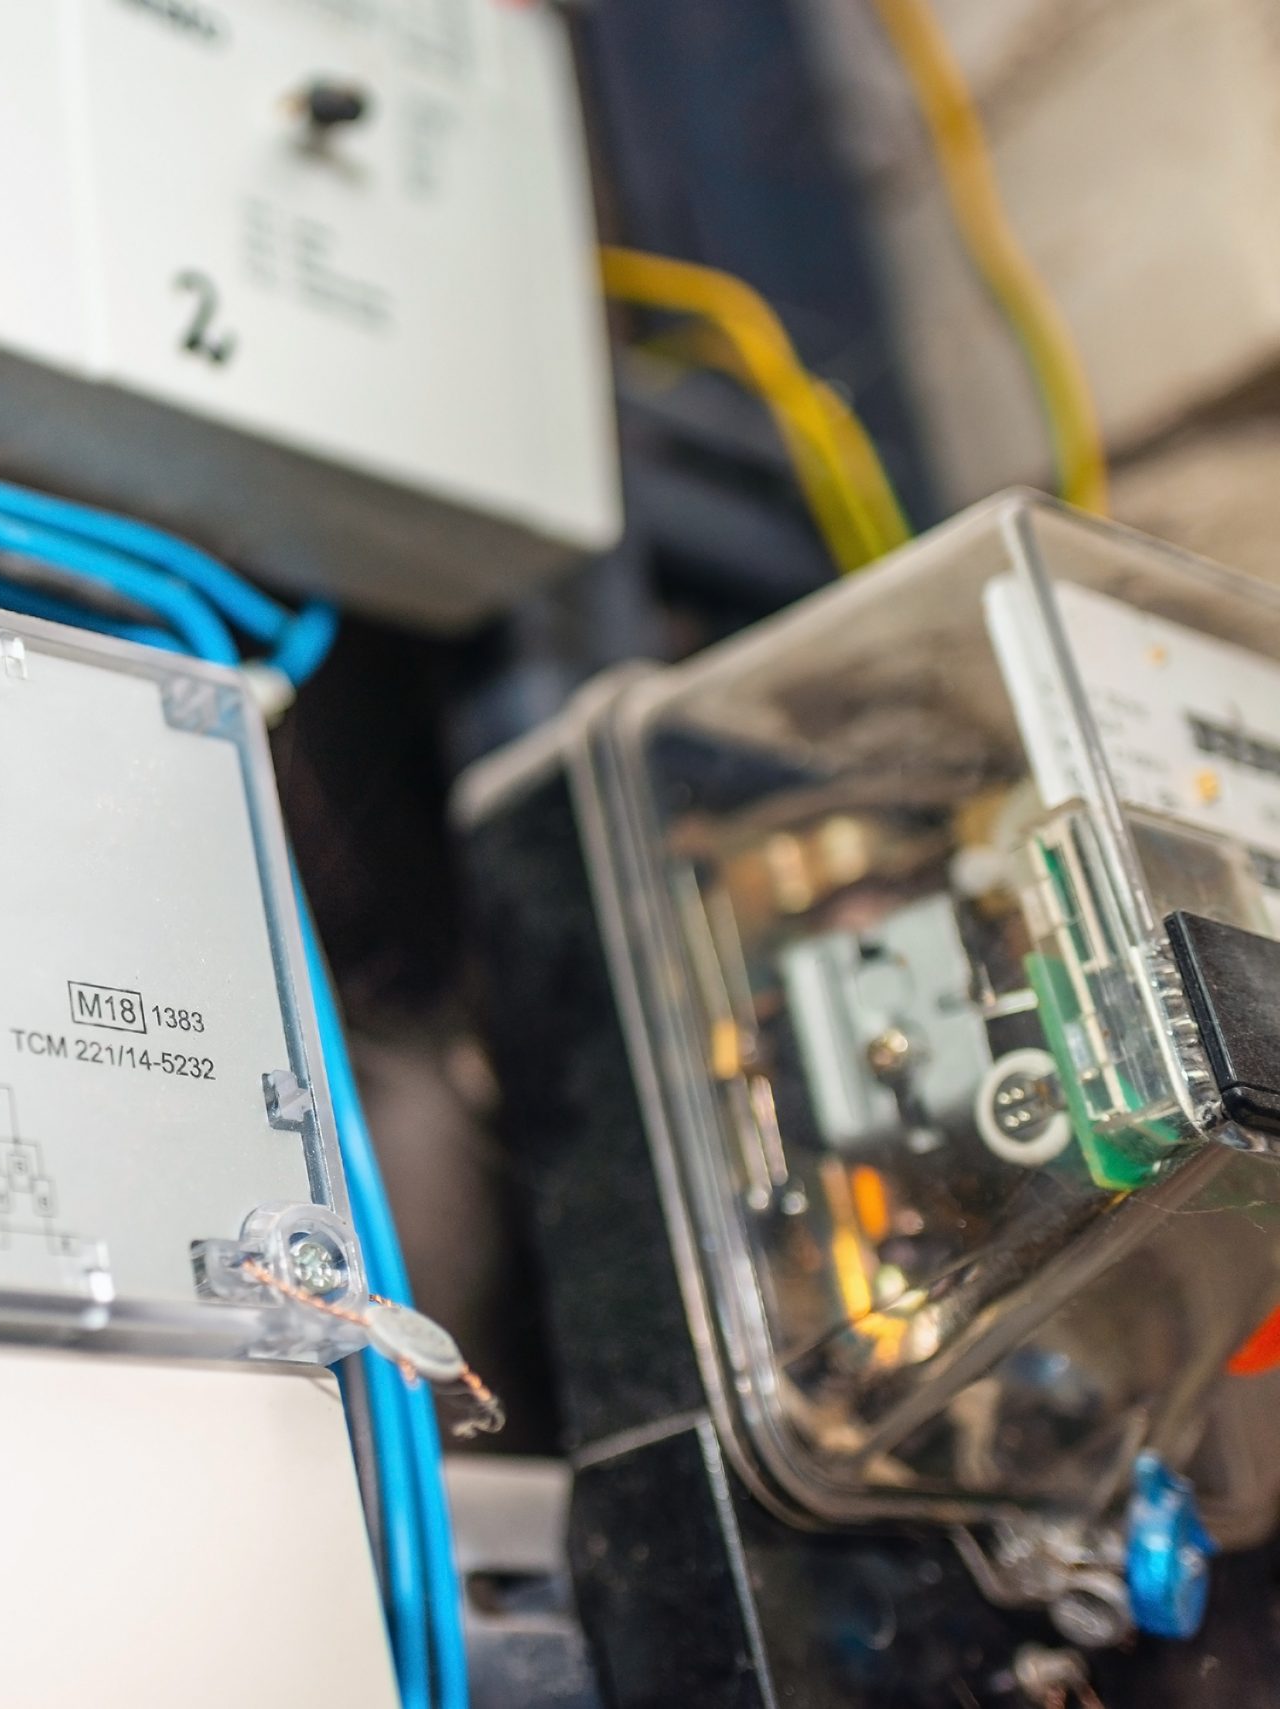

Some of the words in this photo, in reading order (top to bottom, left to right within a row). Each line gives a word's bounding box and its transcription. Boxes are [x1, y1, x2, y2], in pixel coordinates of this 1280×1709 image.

[77, 990, 137, 1025] M18
[151, 1004, 206, 1034] 1383
[9, 1028, 68, 1059] TCM
[74, 1038, 217, 1081] 221/14-5232
